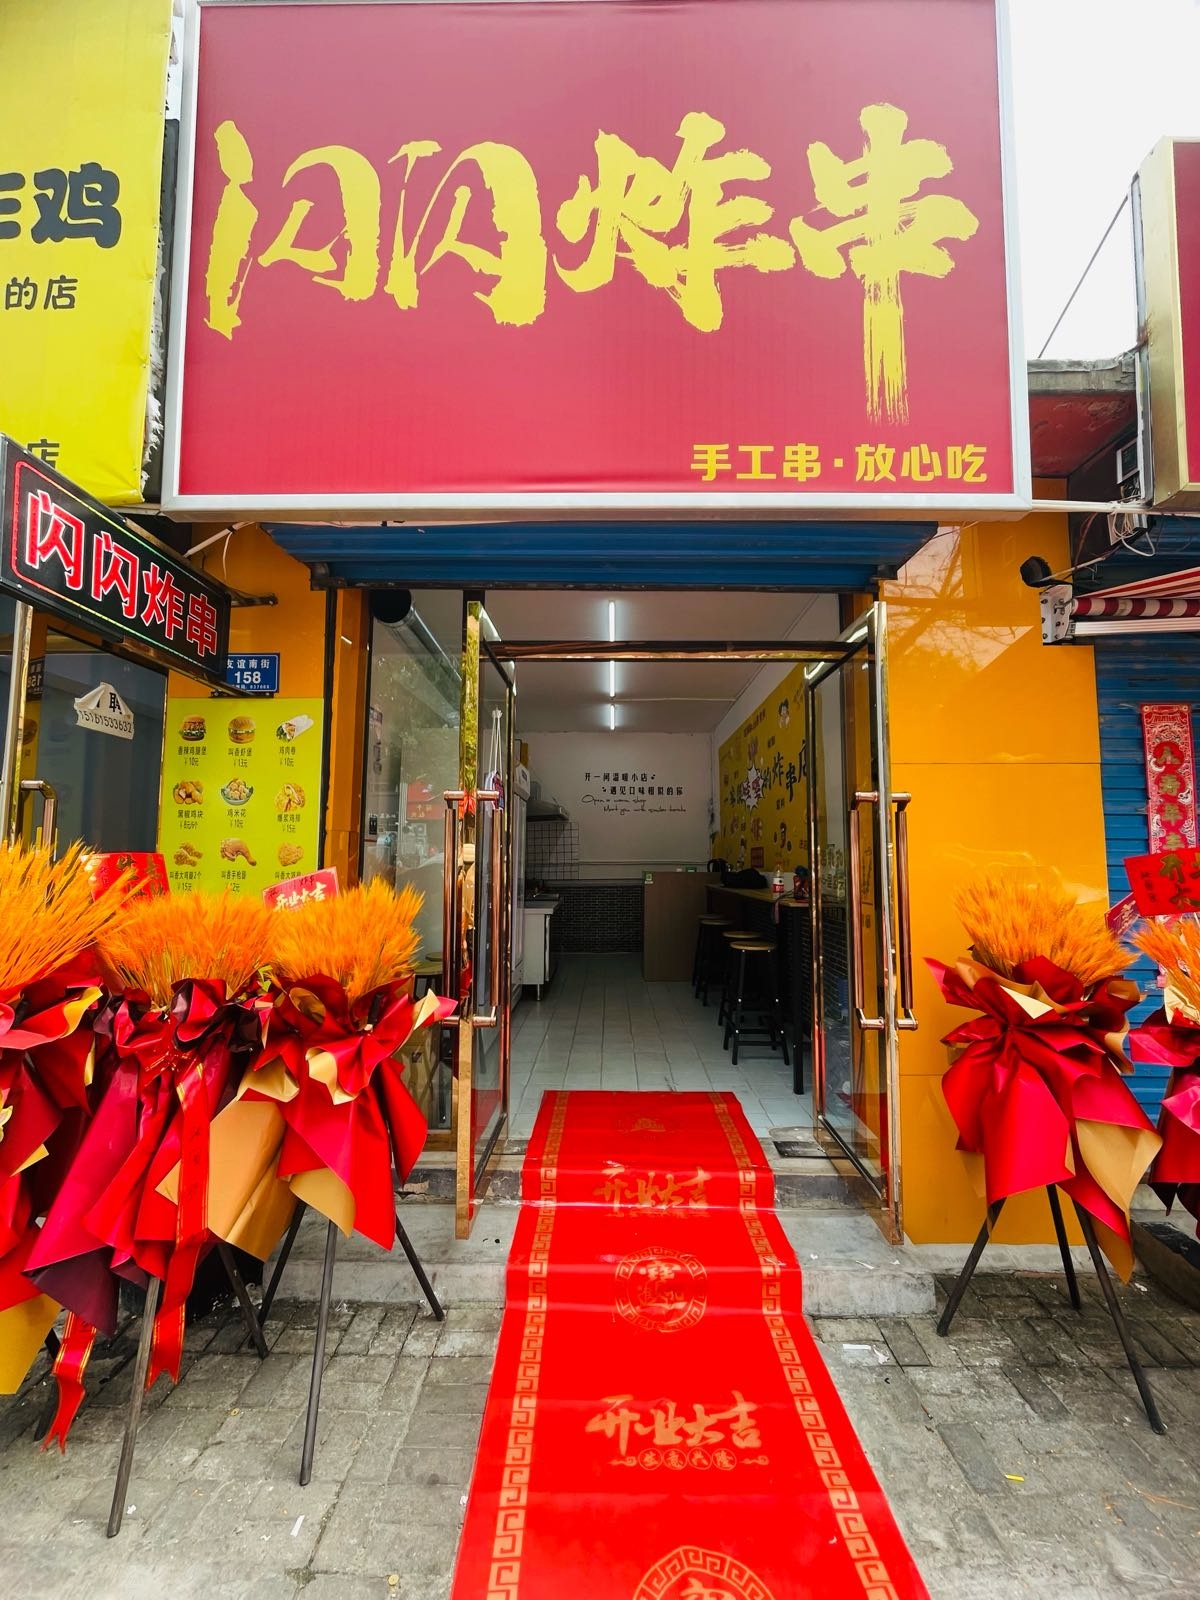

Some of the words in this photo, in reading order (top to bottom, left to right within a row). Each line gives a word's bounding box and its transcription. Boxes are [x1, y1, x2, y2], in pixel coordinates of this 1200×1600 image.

[204, 102, 980, 426] 闪闪炸串
[5, 274, 78, 311] 的店
[690, 442, 988, 484] 手工串·放心吃
[25, 488, 218, 658] 闪闪炸串
[234, 671, 262, 684] 158
[227, 808, 247, 818] 鸡米花
[584, 1389, 762, 1457] 开业大吉
